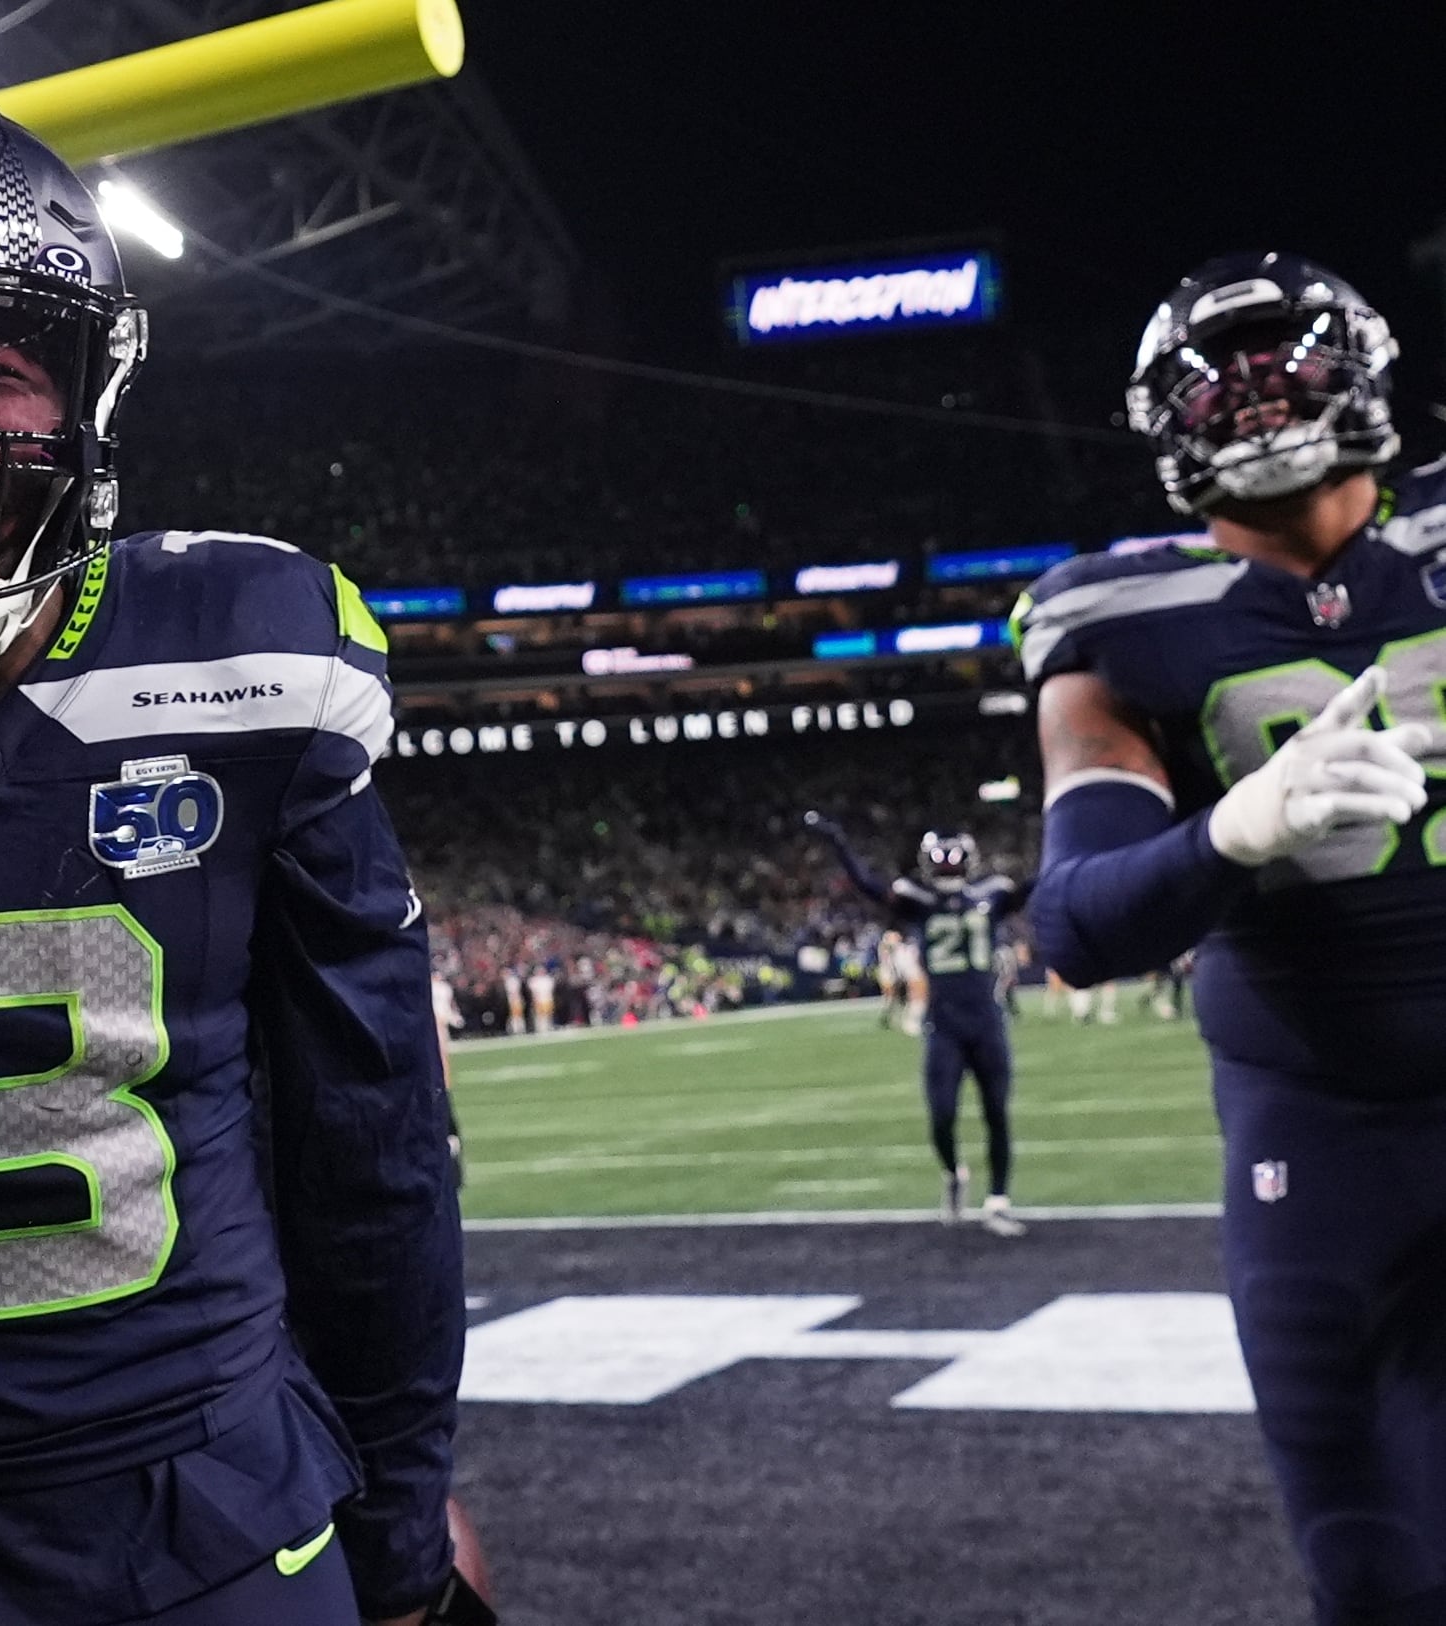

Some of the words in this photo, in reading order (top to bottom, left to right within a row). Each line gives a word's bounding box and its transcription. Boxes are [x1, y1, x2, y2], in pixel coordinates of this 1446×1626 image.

[131, 683, 285, 708] SEAHAWKS
[555, 719, 608, 749] TO
[629, 710, 770, 745] LUMEN
[791, 698, 916, 733] FIELD
[91, 774, 222, 867] 50
[925, 910, 991, 975] 21
